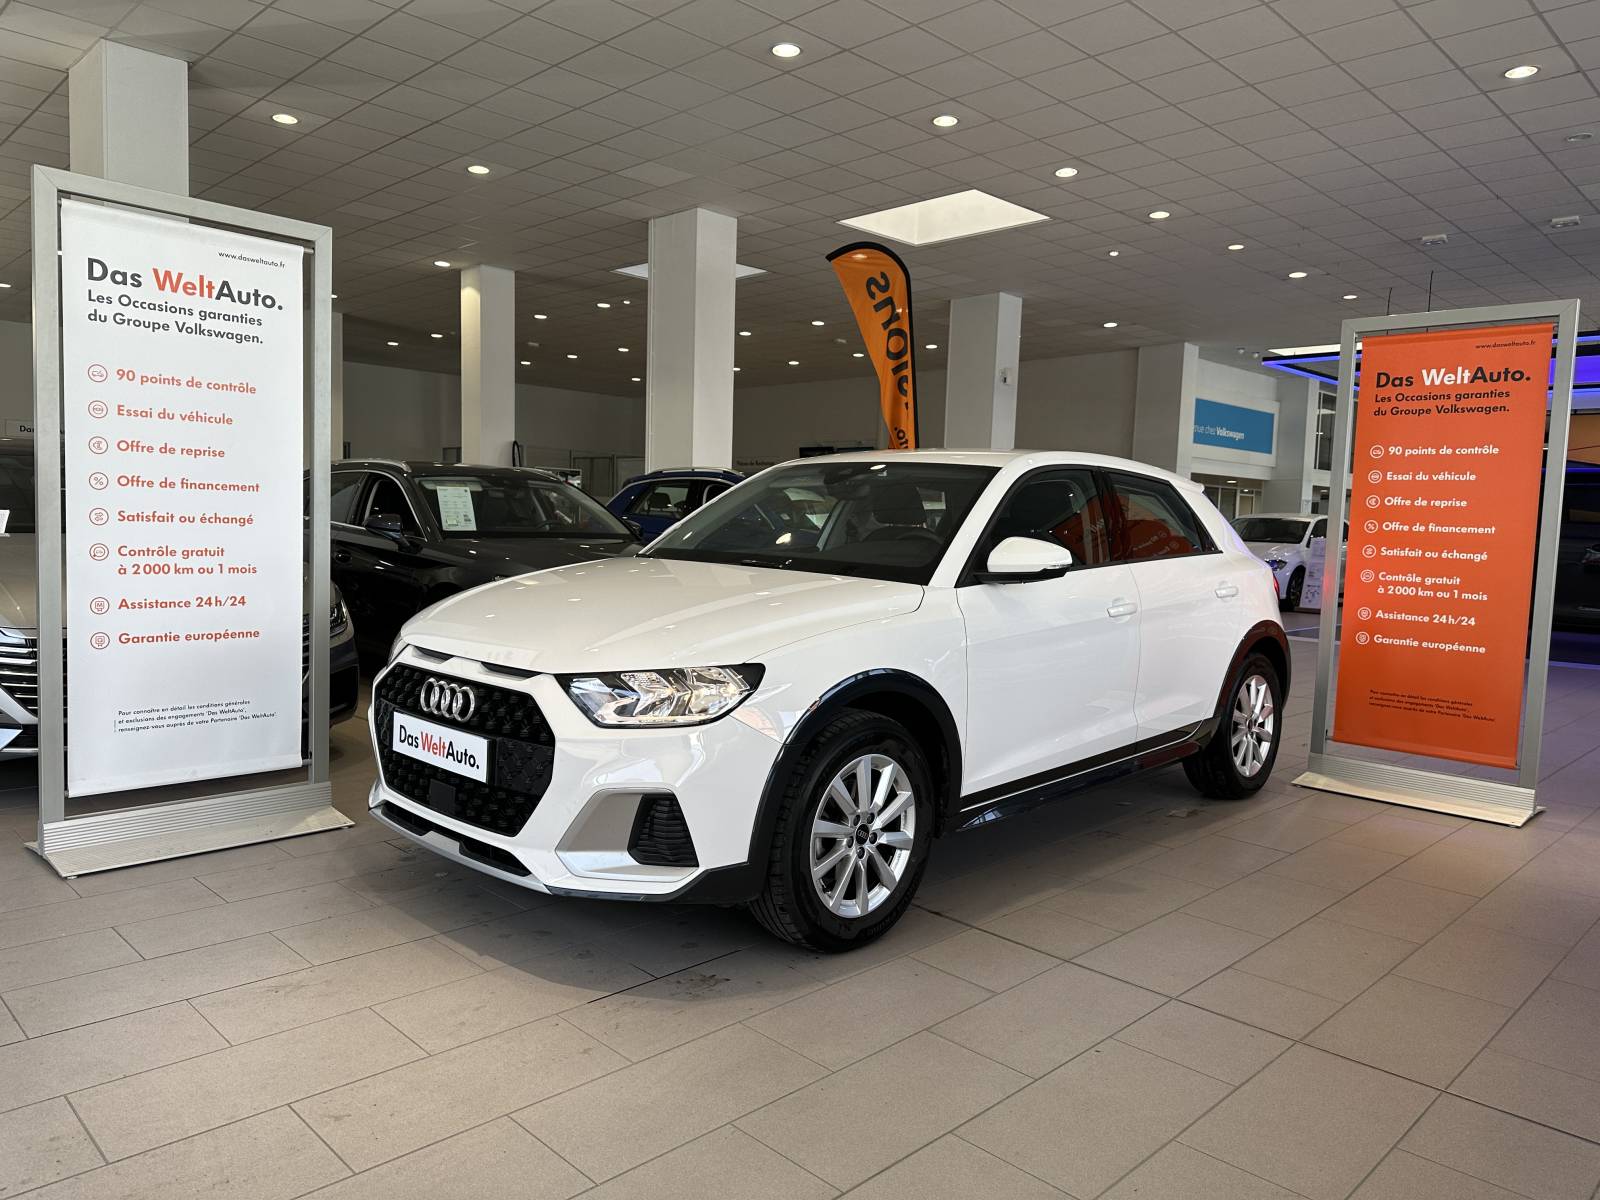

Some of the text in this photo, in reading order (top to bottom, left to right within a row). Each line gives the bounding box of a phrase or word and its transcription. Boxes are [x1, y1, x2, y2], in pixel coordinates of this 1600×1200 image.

[217, 251, 286, 268] www.dasweltauto.fr
[87, 257, 284, 311] Das WeltAuto.
[87, 289, 263, 327] Les Occasions garanties
[87, 309, 264, 344] du Groupe Volkswagen.
[116, 368, 257, 394] 90 points de contrôle
[1376, 366, 1532, 388] Das WeltAuto.
[1375, 389, 1510, 403] Les Occasions garanties
[116, 404, 233, 425] Essai du véhicule
[1373, 403, 1510, 417] du Groupe Volkswagen.
[116, 440, 225, 458] Offre de reprise
[1388, 445, 1500, 456] 90 points de contrôle
[1386, 471, 1476, 480] Essai du véhicule
[117, 475, 260, 493] Offre de financement
[1384, 496, 1467, 508] Offre de reprise
[117, 510, 254, 527] Satisfait ou échangé
[1382, 522, 1496, 534] Offre de financement
[117, 545, 225, 560] Contrôle gratuit
[1380, 546, 1488, 562] Satisfait ou échangé
[117, 564, 127, 575] à
[174, 563, 194, 575] km
[218, 563, 224, 574] 1
[228, 564, 257, 574] mois
[1379, 572, 1461, 585] Contrôle gratuit
[1377, 585, 1384, 594] à
[1418, 587, 1433, 597] km
[1453, 590, 1458, 598] 1
[1461, 591, 1488, 601] mois
[118, 598, 191, 609] Assistance
[1375, 610, 1430, 622] Assistance
[118, 629, 260, 644] Garantie européenne
[1373, 634, 1486, 654] Garantie européenne
[399, 724, 480, 769] Das WeltAuto.
